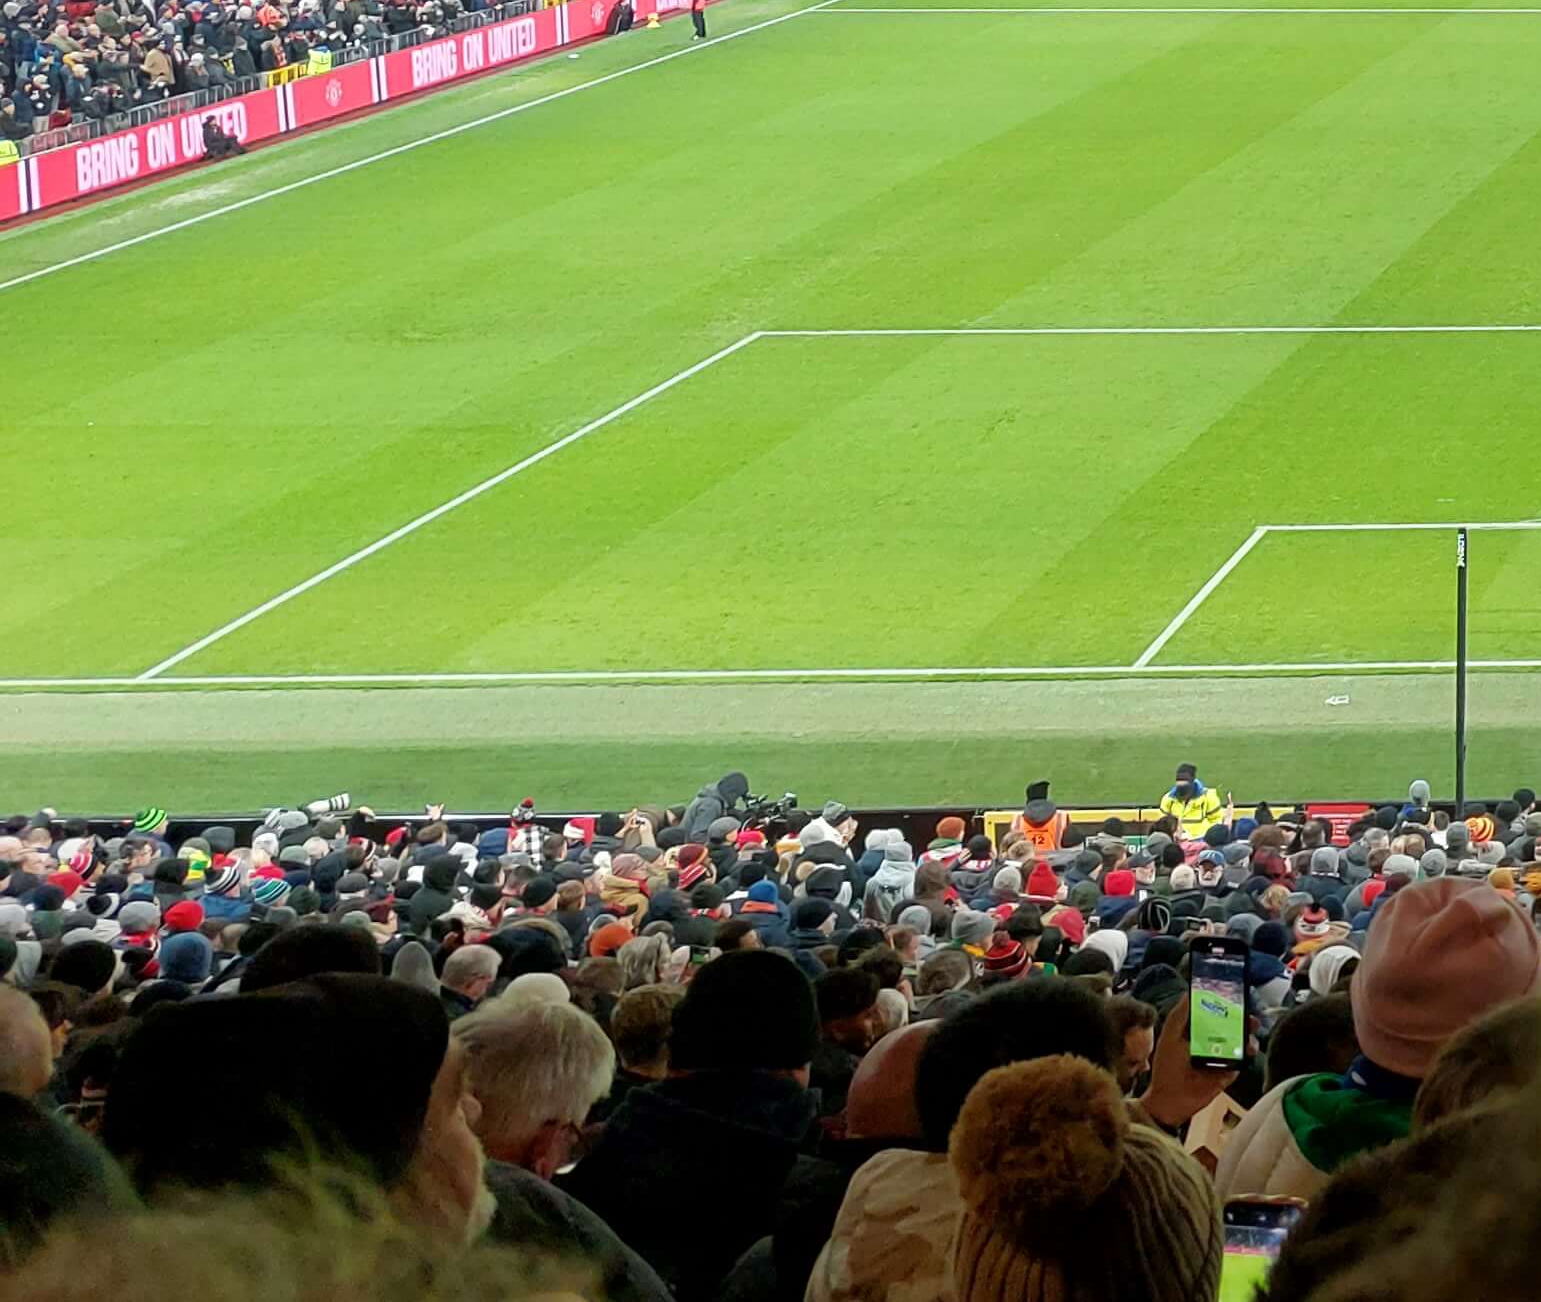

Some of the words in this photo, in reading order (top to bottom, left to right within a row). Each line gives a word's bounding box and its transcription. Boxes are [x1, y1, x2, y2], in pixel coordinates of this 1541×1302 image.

[411, 41, 457, 89] BRING
[463, 32, 484, 70] ON
[488, 17, 536, 63] UNITED
[77, 134, 140, 192] BRING
[147, 122, 177, 168] ON
[1031, 836, 1046, 845] 12
